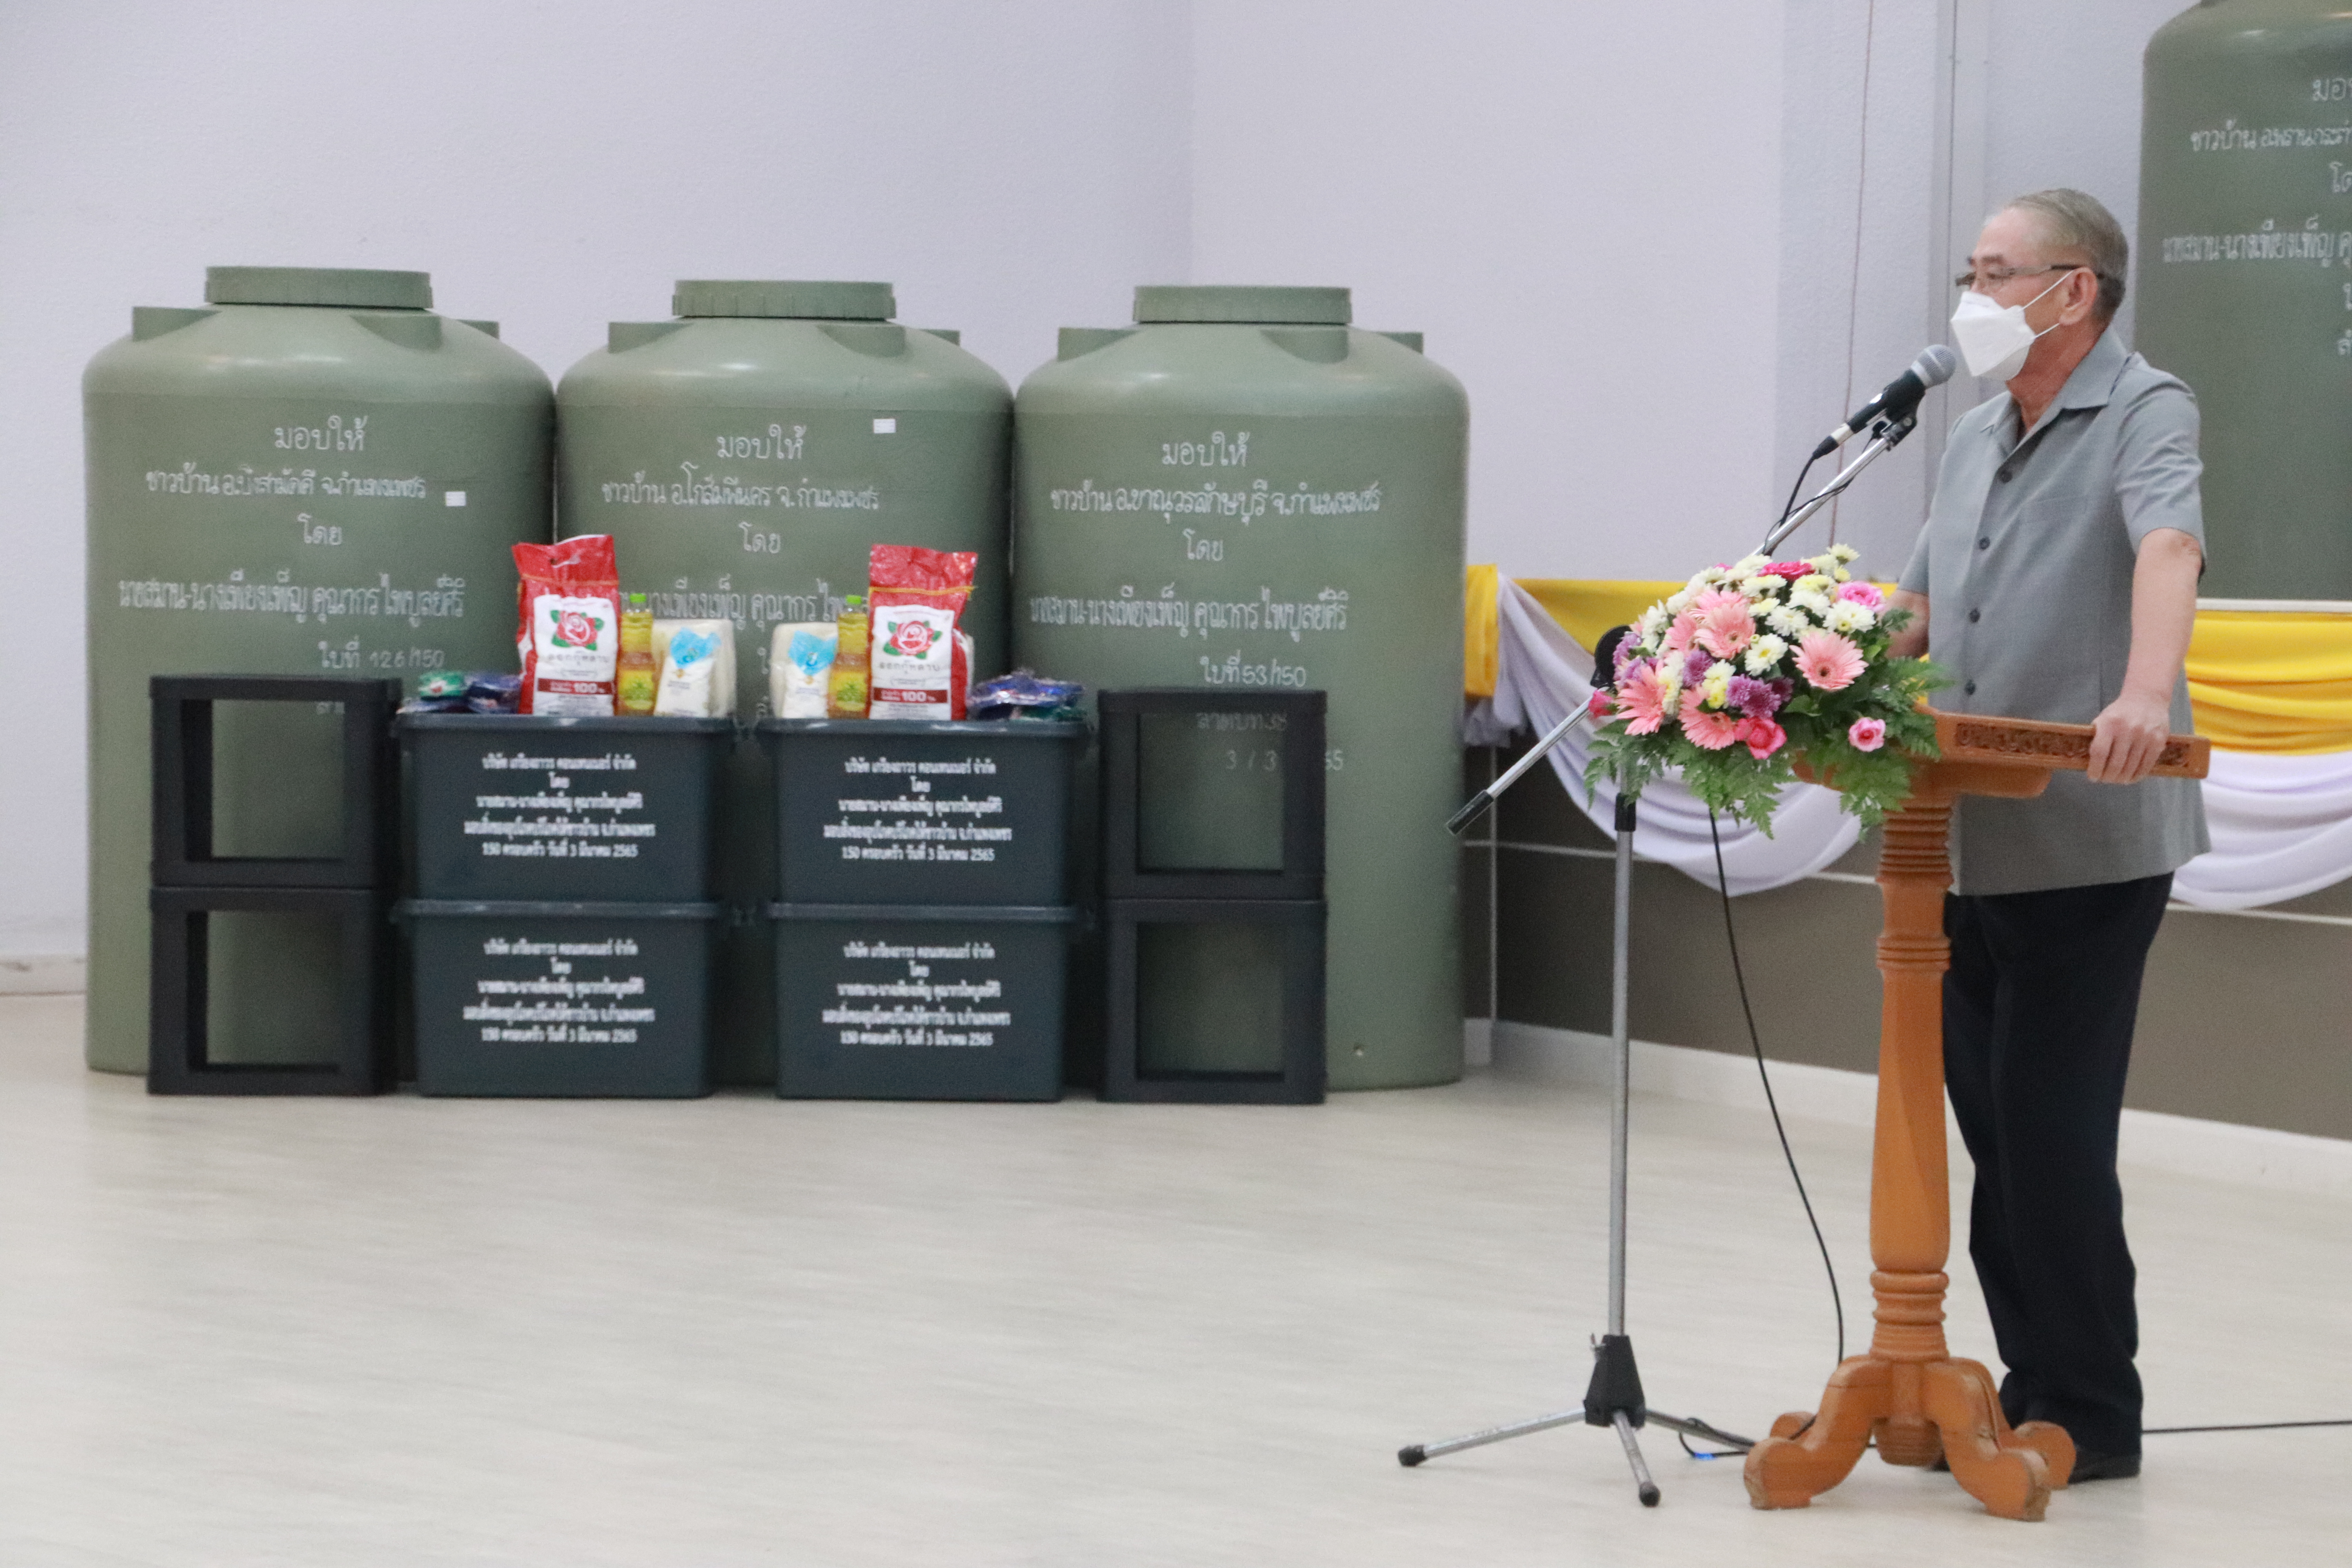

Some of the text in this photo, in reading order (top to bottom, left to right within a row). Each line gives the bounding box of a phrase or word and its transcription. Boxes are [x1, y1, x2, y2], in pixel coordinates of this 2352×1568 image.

[2313, 78, 2352, 102] มอ
[2191, 119, 2257, 151] ชาวบ้าน
[274, 415, 368, 451] มอบให้
[717, 423, 807, 460] มอบให้
[1161, 431, 1250, 467] มอบให้
[146, 462, 220, 495] ชาวบ้าน
[601, 470, 667, 504] ชาวบ้าน
[1051, 479, 1112, 512] ชาวบ้าน
[297, 512, 343, 546] โดย
[739, 521, 781, 554] โดย
[1183, 528, 1224, 562] โดย
[573, 682, 597, 693] 100
[902, 691, 927, 702] 100
